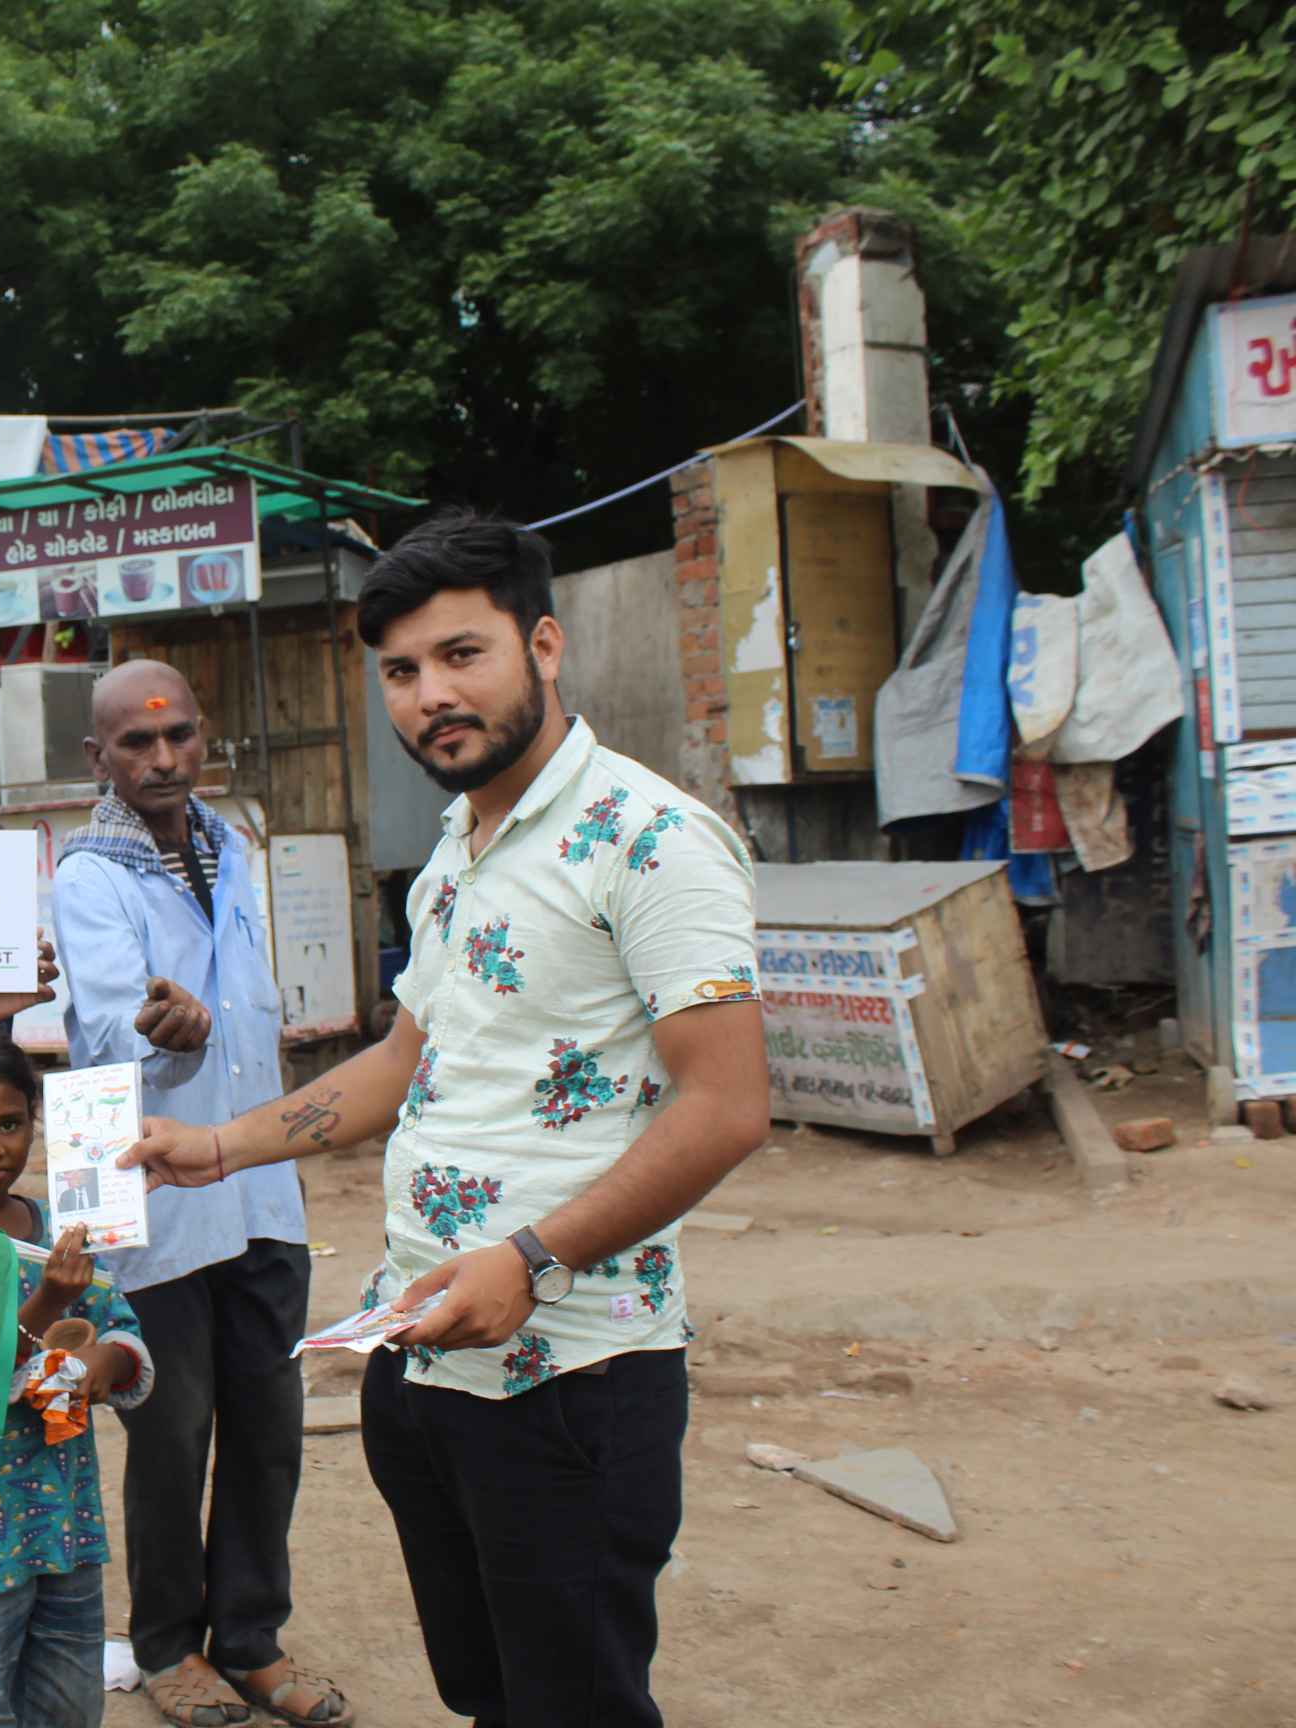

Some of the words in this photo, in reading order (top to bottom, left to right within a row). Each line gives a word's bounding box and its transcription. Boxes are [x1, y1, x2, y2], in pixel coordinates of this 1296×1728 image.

[36, 509, 60, 528] ચા
[83, 493, 128, 523] કોફી
[151, 481, 235, 514] બોનવીટા
[4, 538, 38, 565] હોટ
[44, 530, 109, 558] ચોકલેટ
